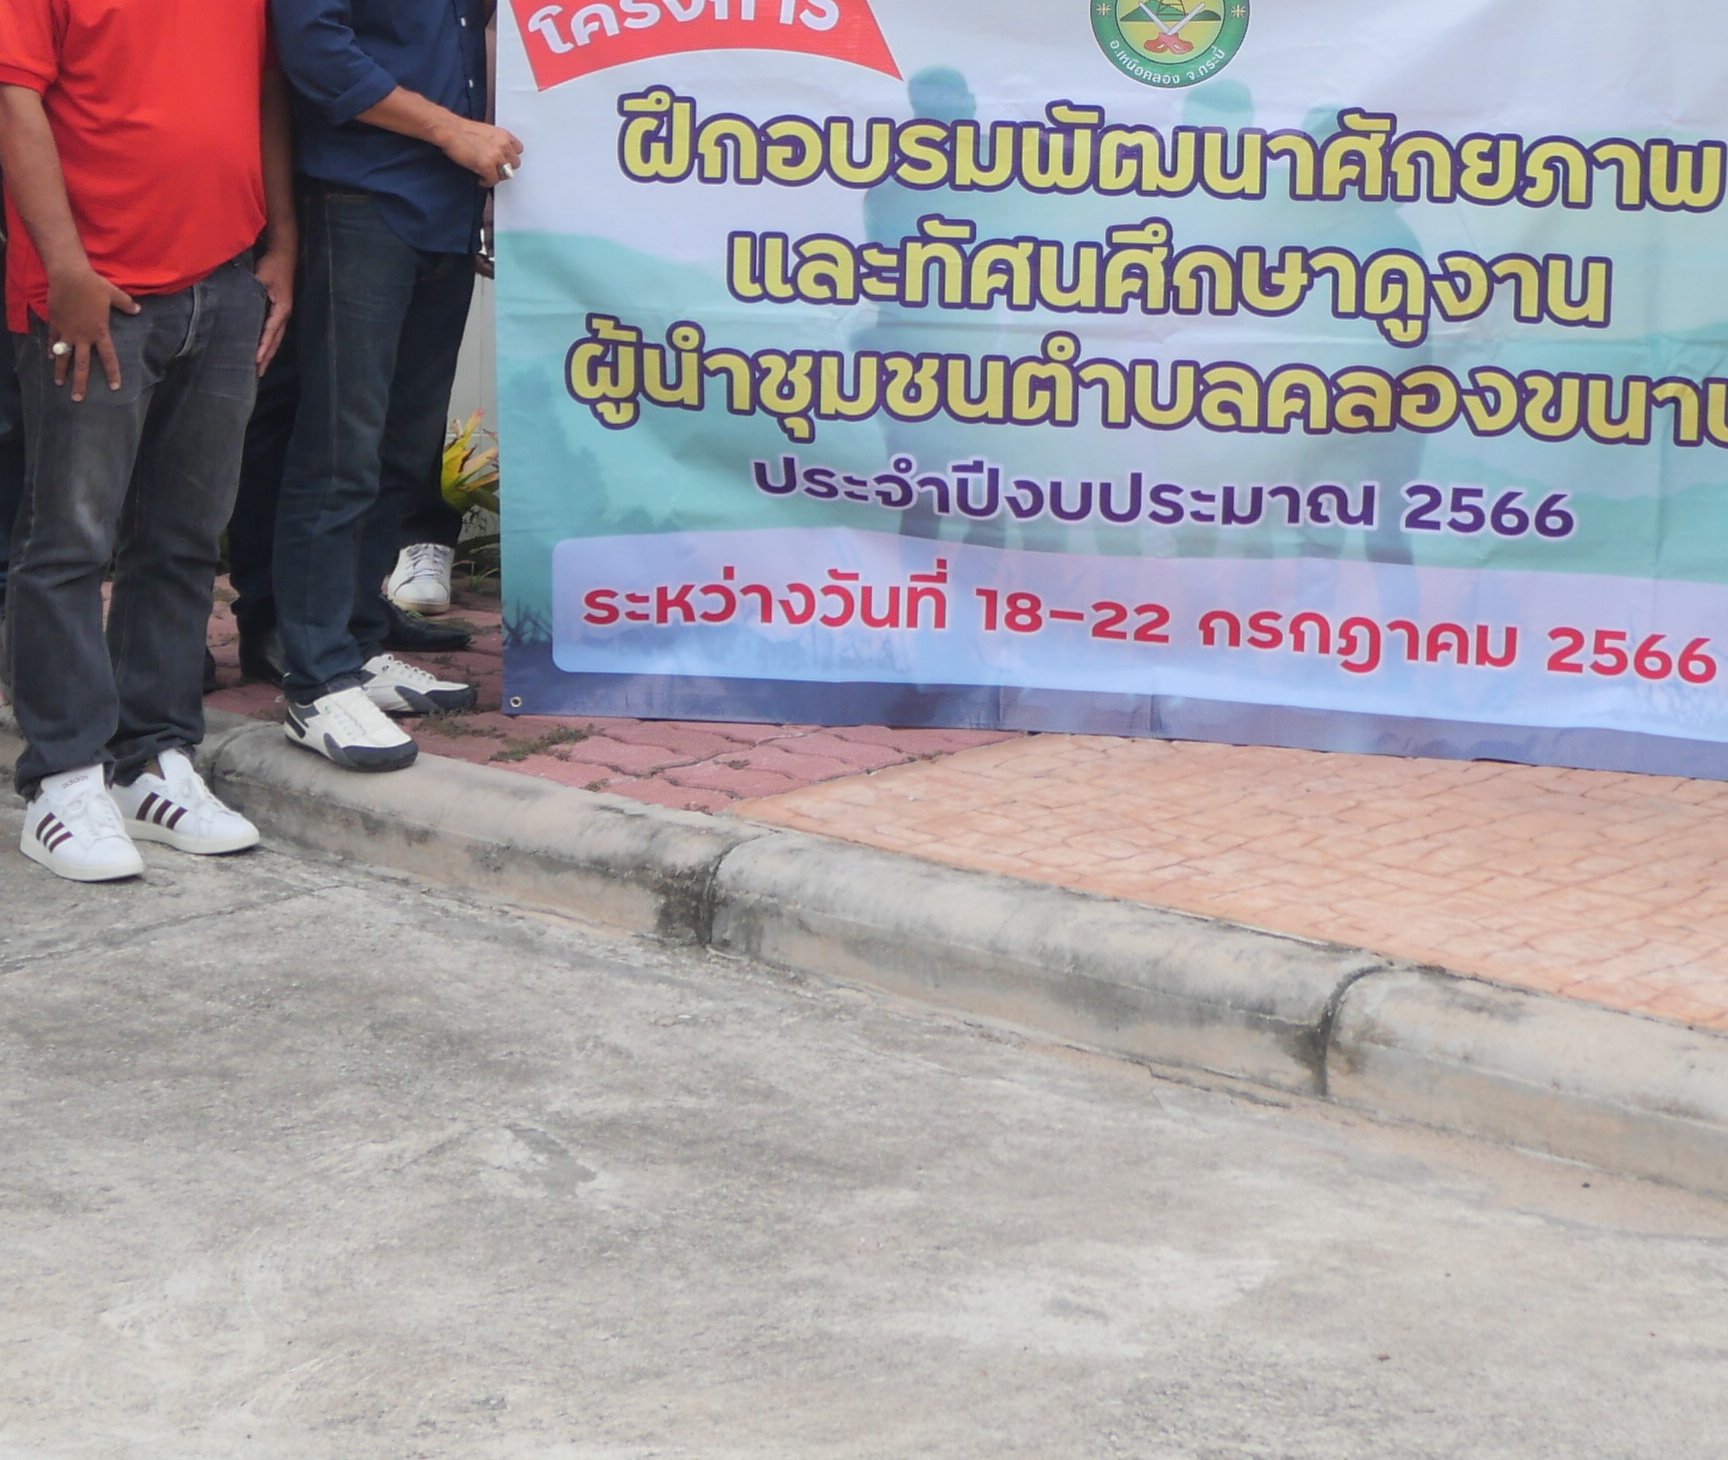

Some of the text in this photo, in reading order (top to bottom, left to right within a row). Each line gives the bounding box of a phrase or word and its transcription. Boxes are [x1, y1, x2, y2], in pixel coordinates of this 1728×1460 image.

[619, 87, 1726, 213] ฝึกอบรมพัฒนาศักยภาพ
[726, 220, 1611, 346] และทัศนศึกษาดูงาน
[752, 455, 1575, 538] ประจำปีงบประมาณ 2566
[583, 558, 947, 629] ระหว่างวันที่
[1198, 607, 1517, 674] กรกฎาคม
[1546, 626, 1719, 684] 2566
